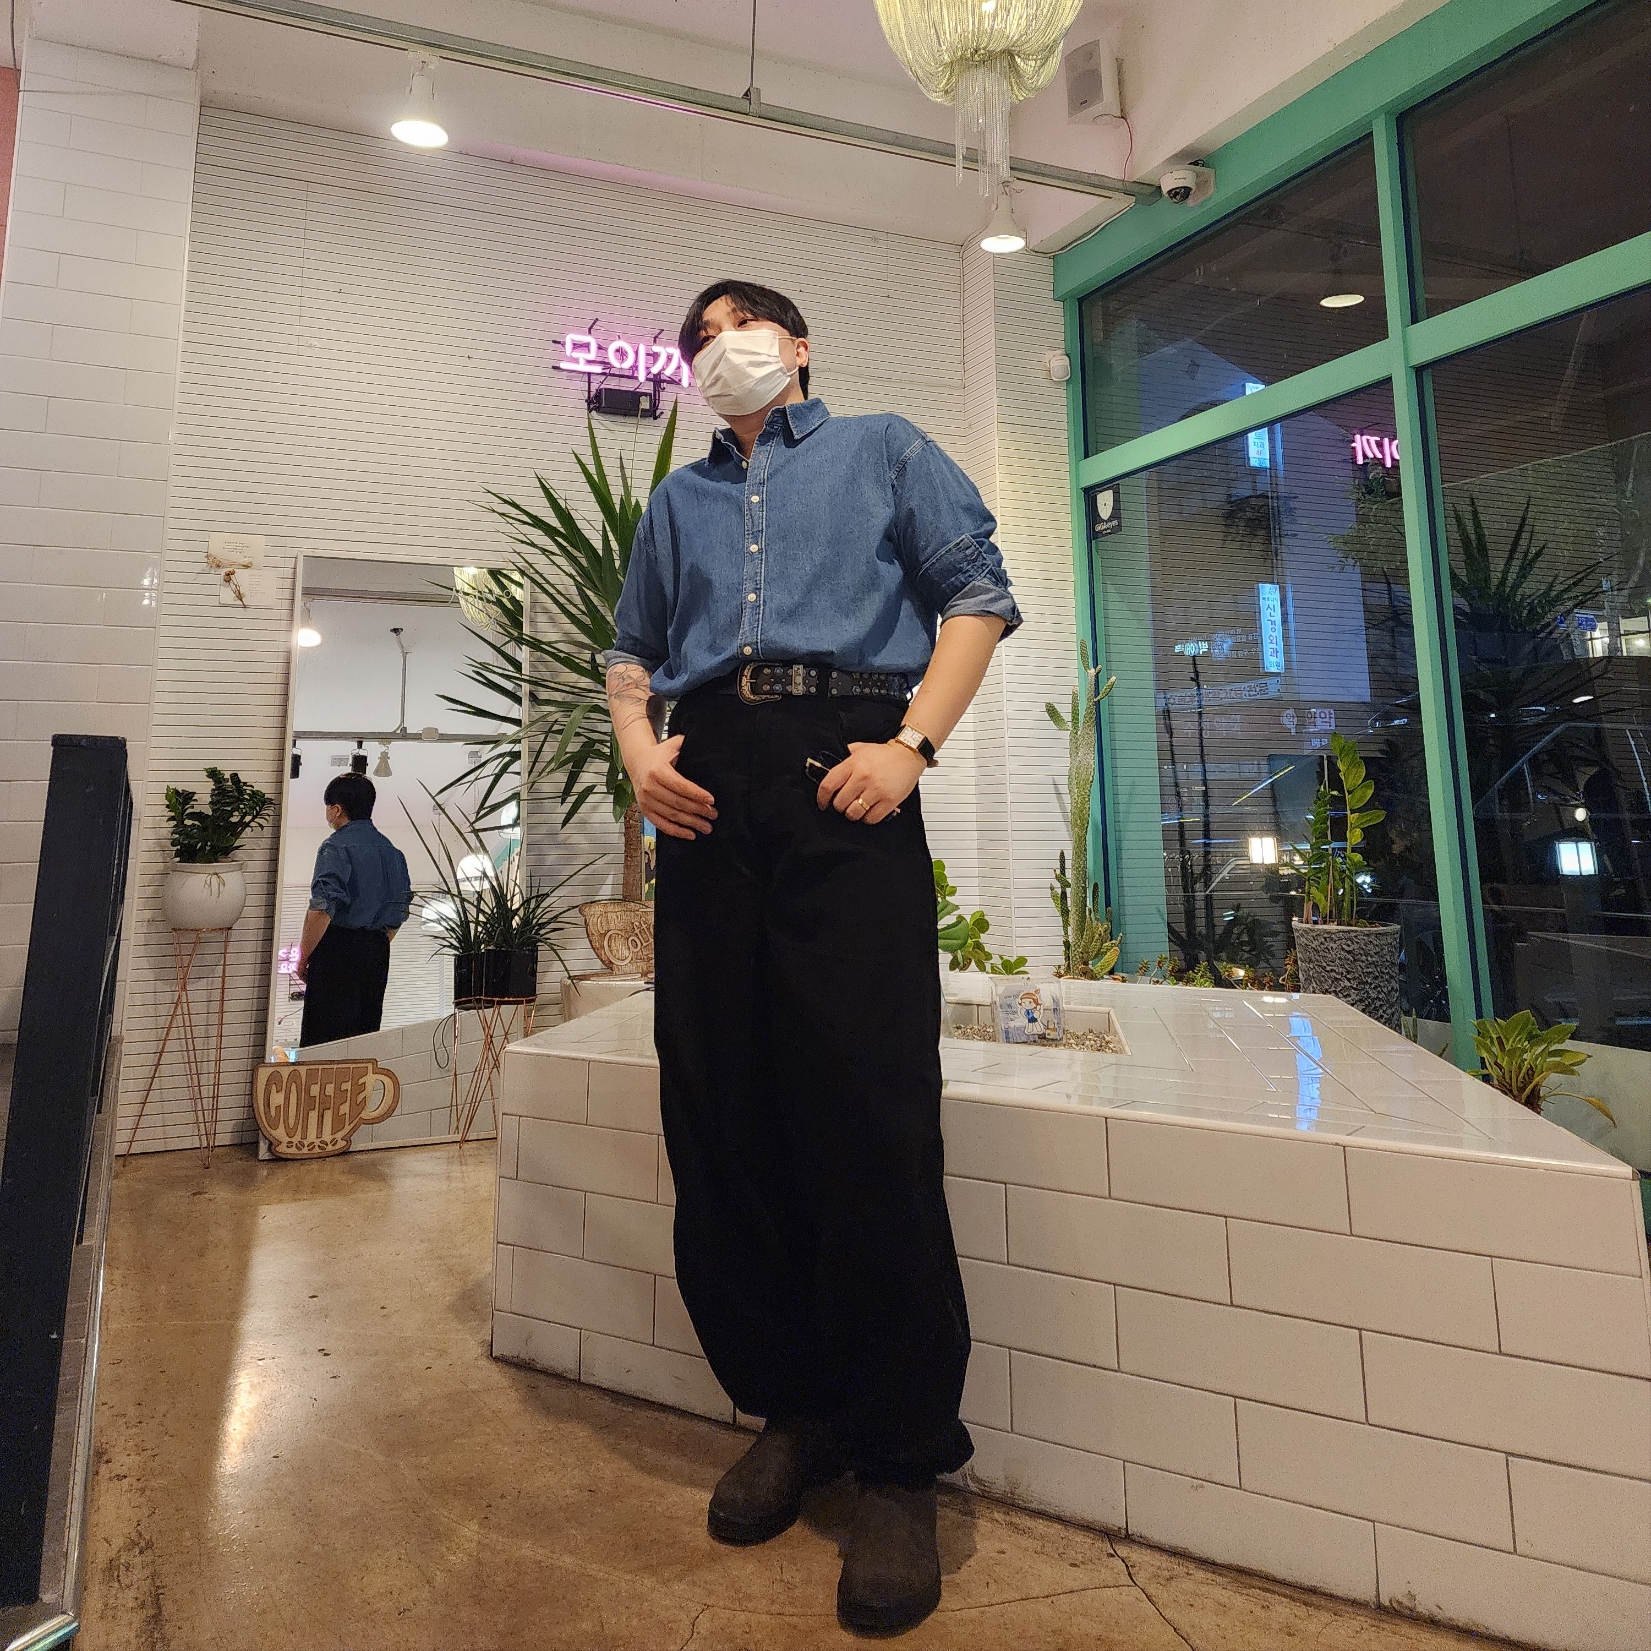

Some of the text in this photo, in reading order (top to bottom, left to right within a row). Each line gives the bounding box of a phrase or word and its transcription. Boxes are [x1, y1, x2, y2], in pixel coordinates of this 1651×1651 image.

[1265, 603, 1279, 658] 신경외과
[1319, 710, 1333, 727] 약
[603, 917, 654, 966] Coff
[263, 1066, 368, 1139] COFFEE
